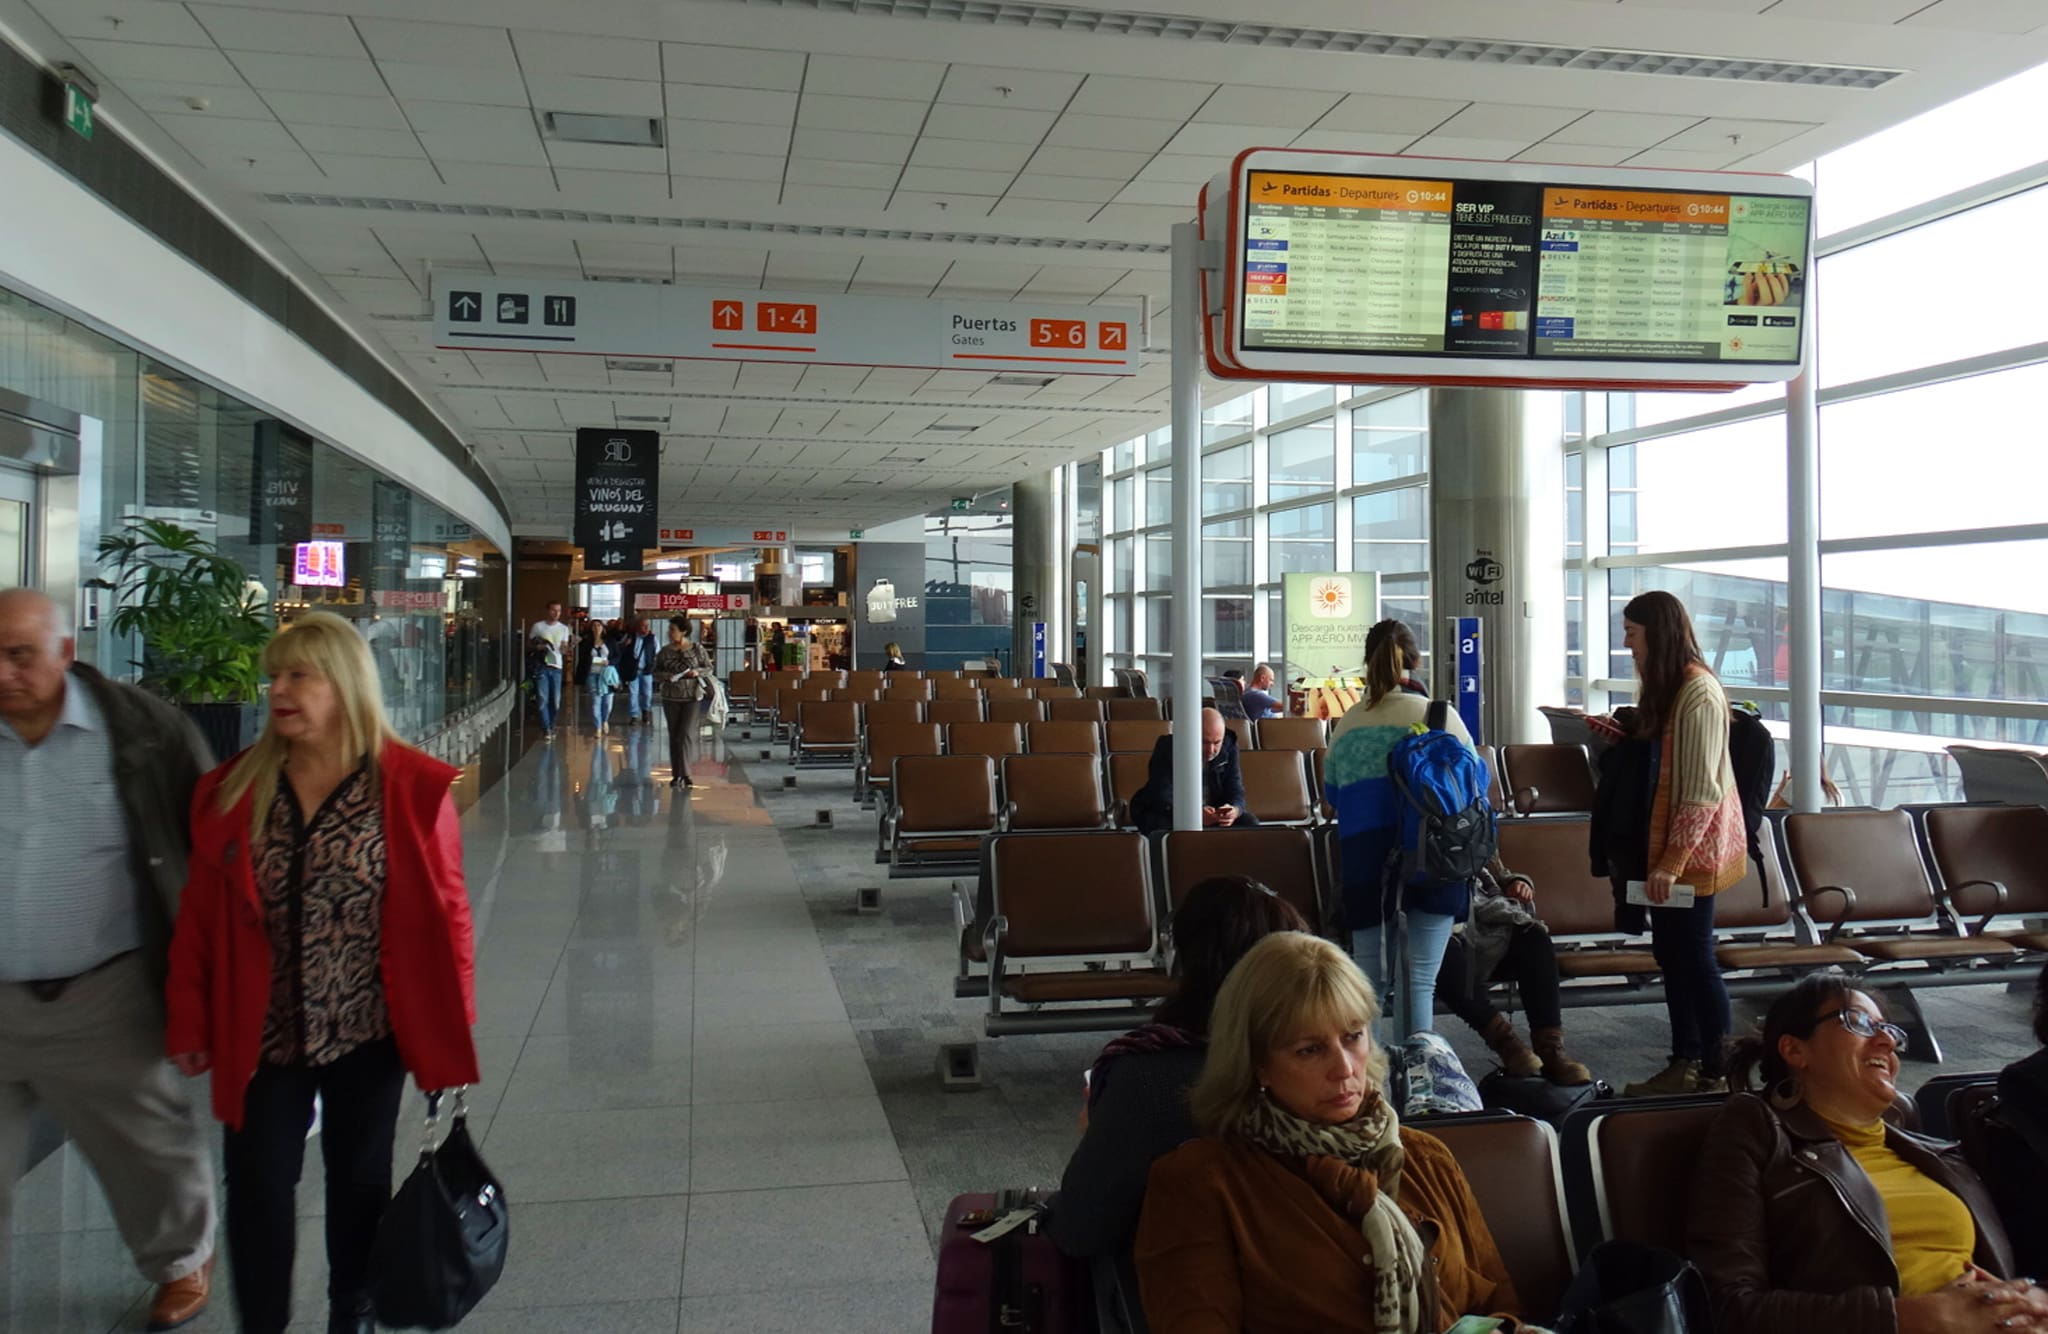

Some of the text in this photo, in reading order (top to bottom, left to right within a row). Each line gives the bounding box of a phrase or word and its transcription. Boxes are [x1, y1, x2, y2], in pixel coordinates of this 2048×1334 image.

[1282, 184, 1331, 197] Partidas
[1340, 187, 1400, 201] Departures
[1420, 191, 1446, 201] 10:44
[1456, 203, 1476, 212] SER
[1478, 204, 1494, 213] VIP
[1573, 198, 1618, 210] Partidas
[1626, 201, 1681, 214] Departures
[1699, 204, 1724, 214] 10:44
[1476, 213, 1490, 223] SUS
[1545, 231, 1566, 240] Azul
[952, 315, 1017, 332] Puertas
[952, 334, 985, 346] Gates
[589, 487, 645, 502] VINOS DEL
[589, 503, 644, 513] URUGUAY
[663, 594, 689, 605] 10%
[895, 596, 918, 608] FREE
[1465, 588, 1504, 605] antel
